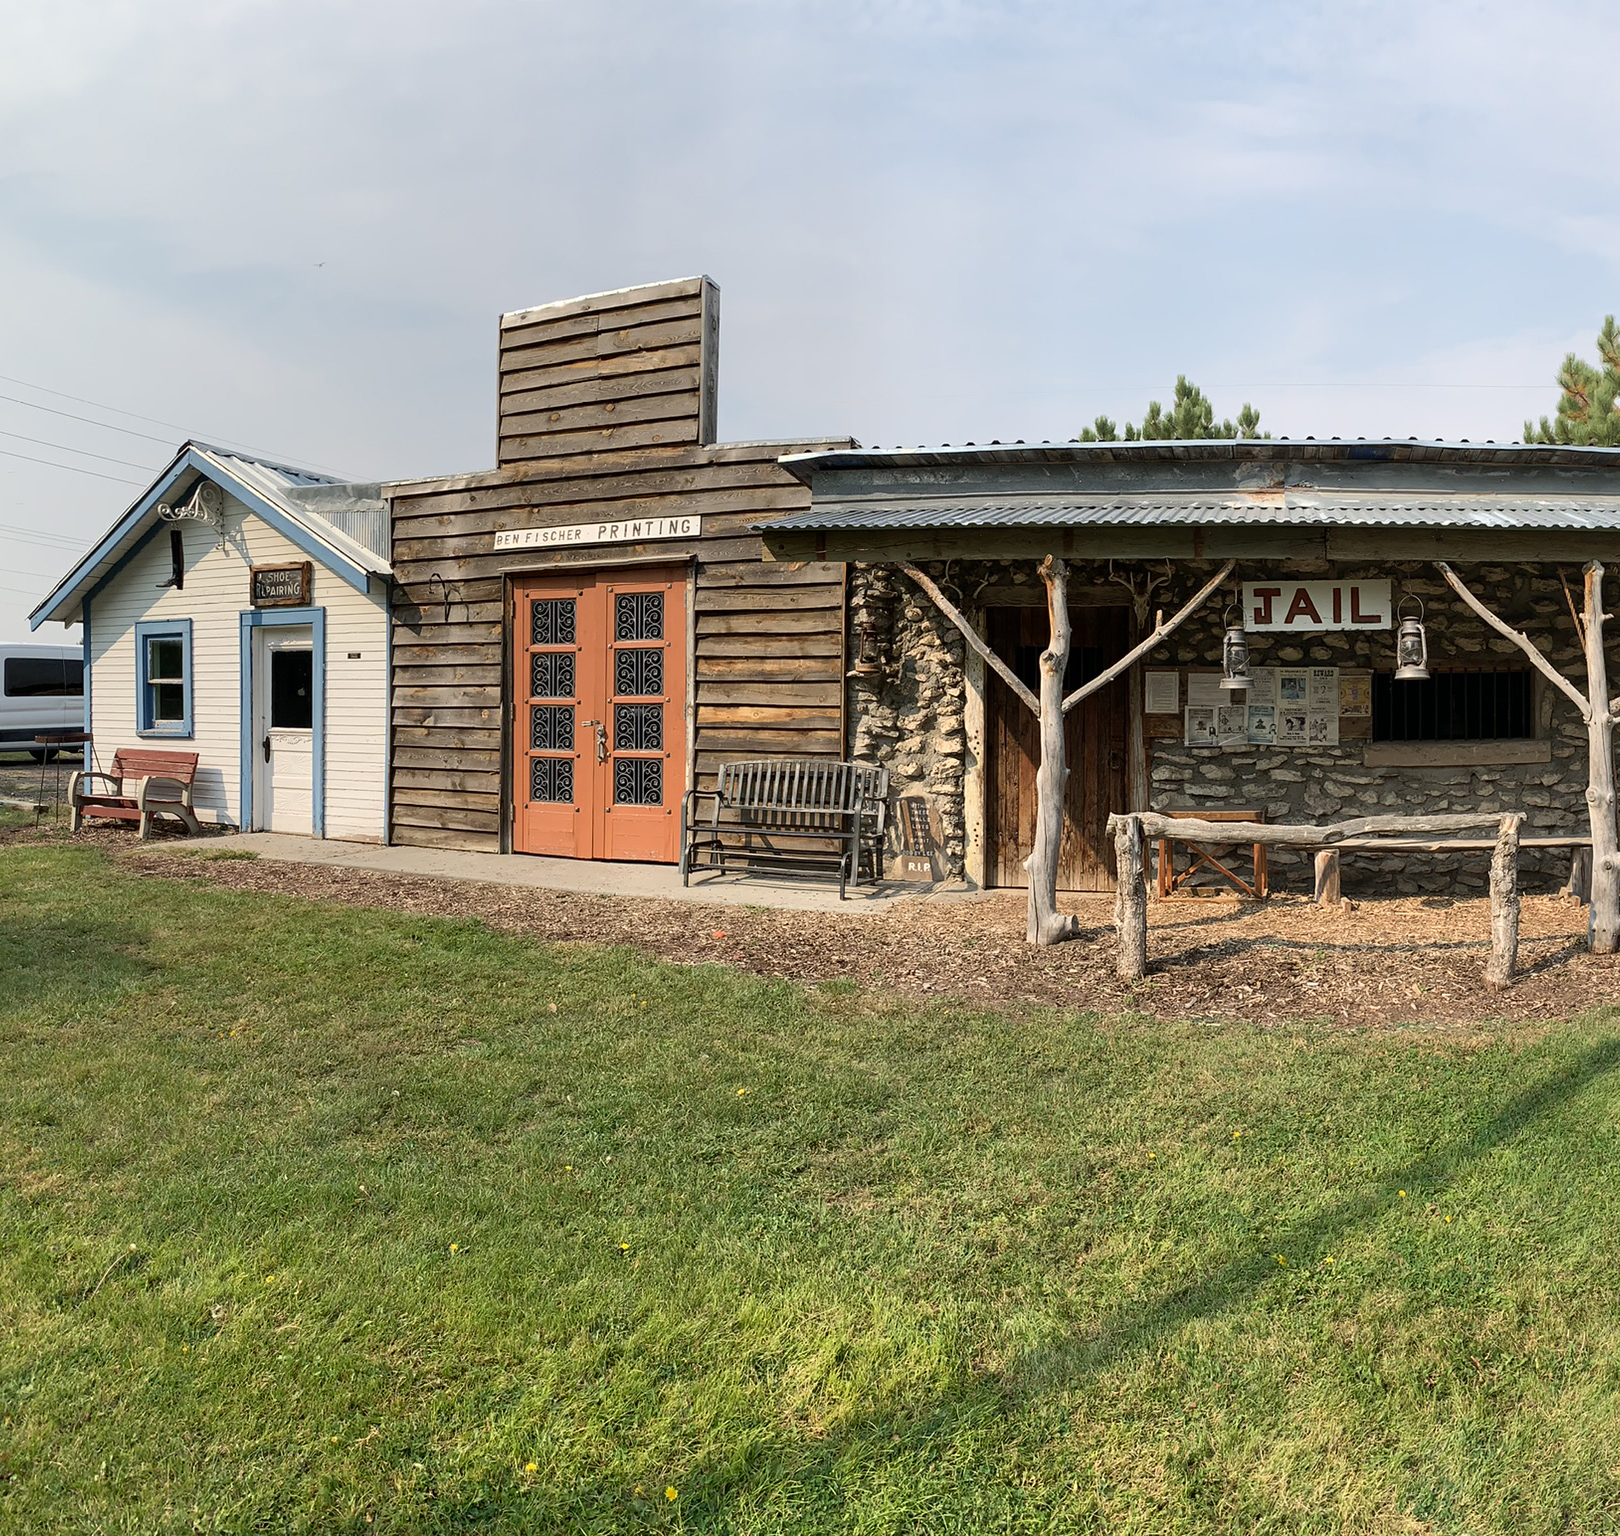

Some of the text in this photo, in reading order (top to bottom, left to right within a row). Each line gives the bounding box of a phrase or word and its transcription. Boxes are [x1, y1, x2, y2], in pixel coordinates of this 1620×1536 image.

[496, 519, 691, 545] BEN FISCHER PRINTING
[268, 572, 290, 582] SHOE
[1253, 587, 1382, 624] JAIL
[908, 862, 931, 872] R.I.P.
